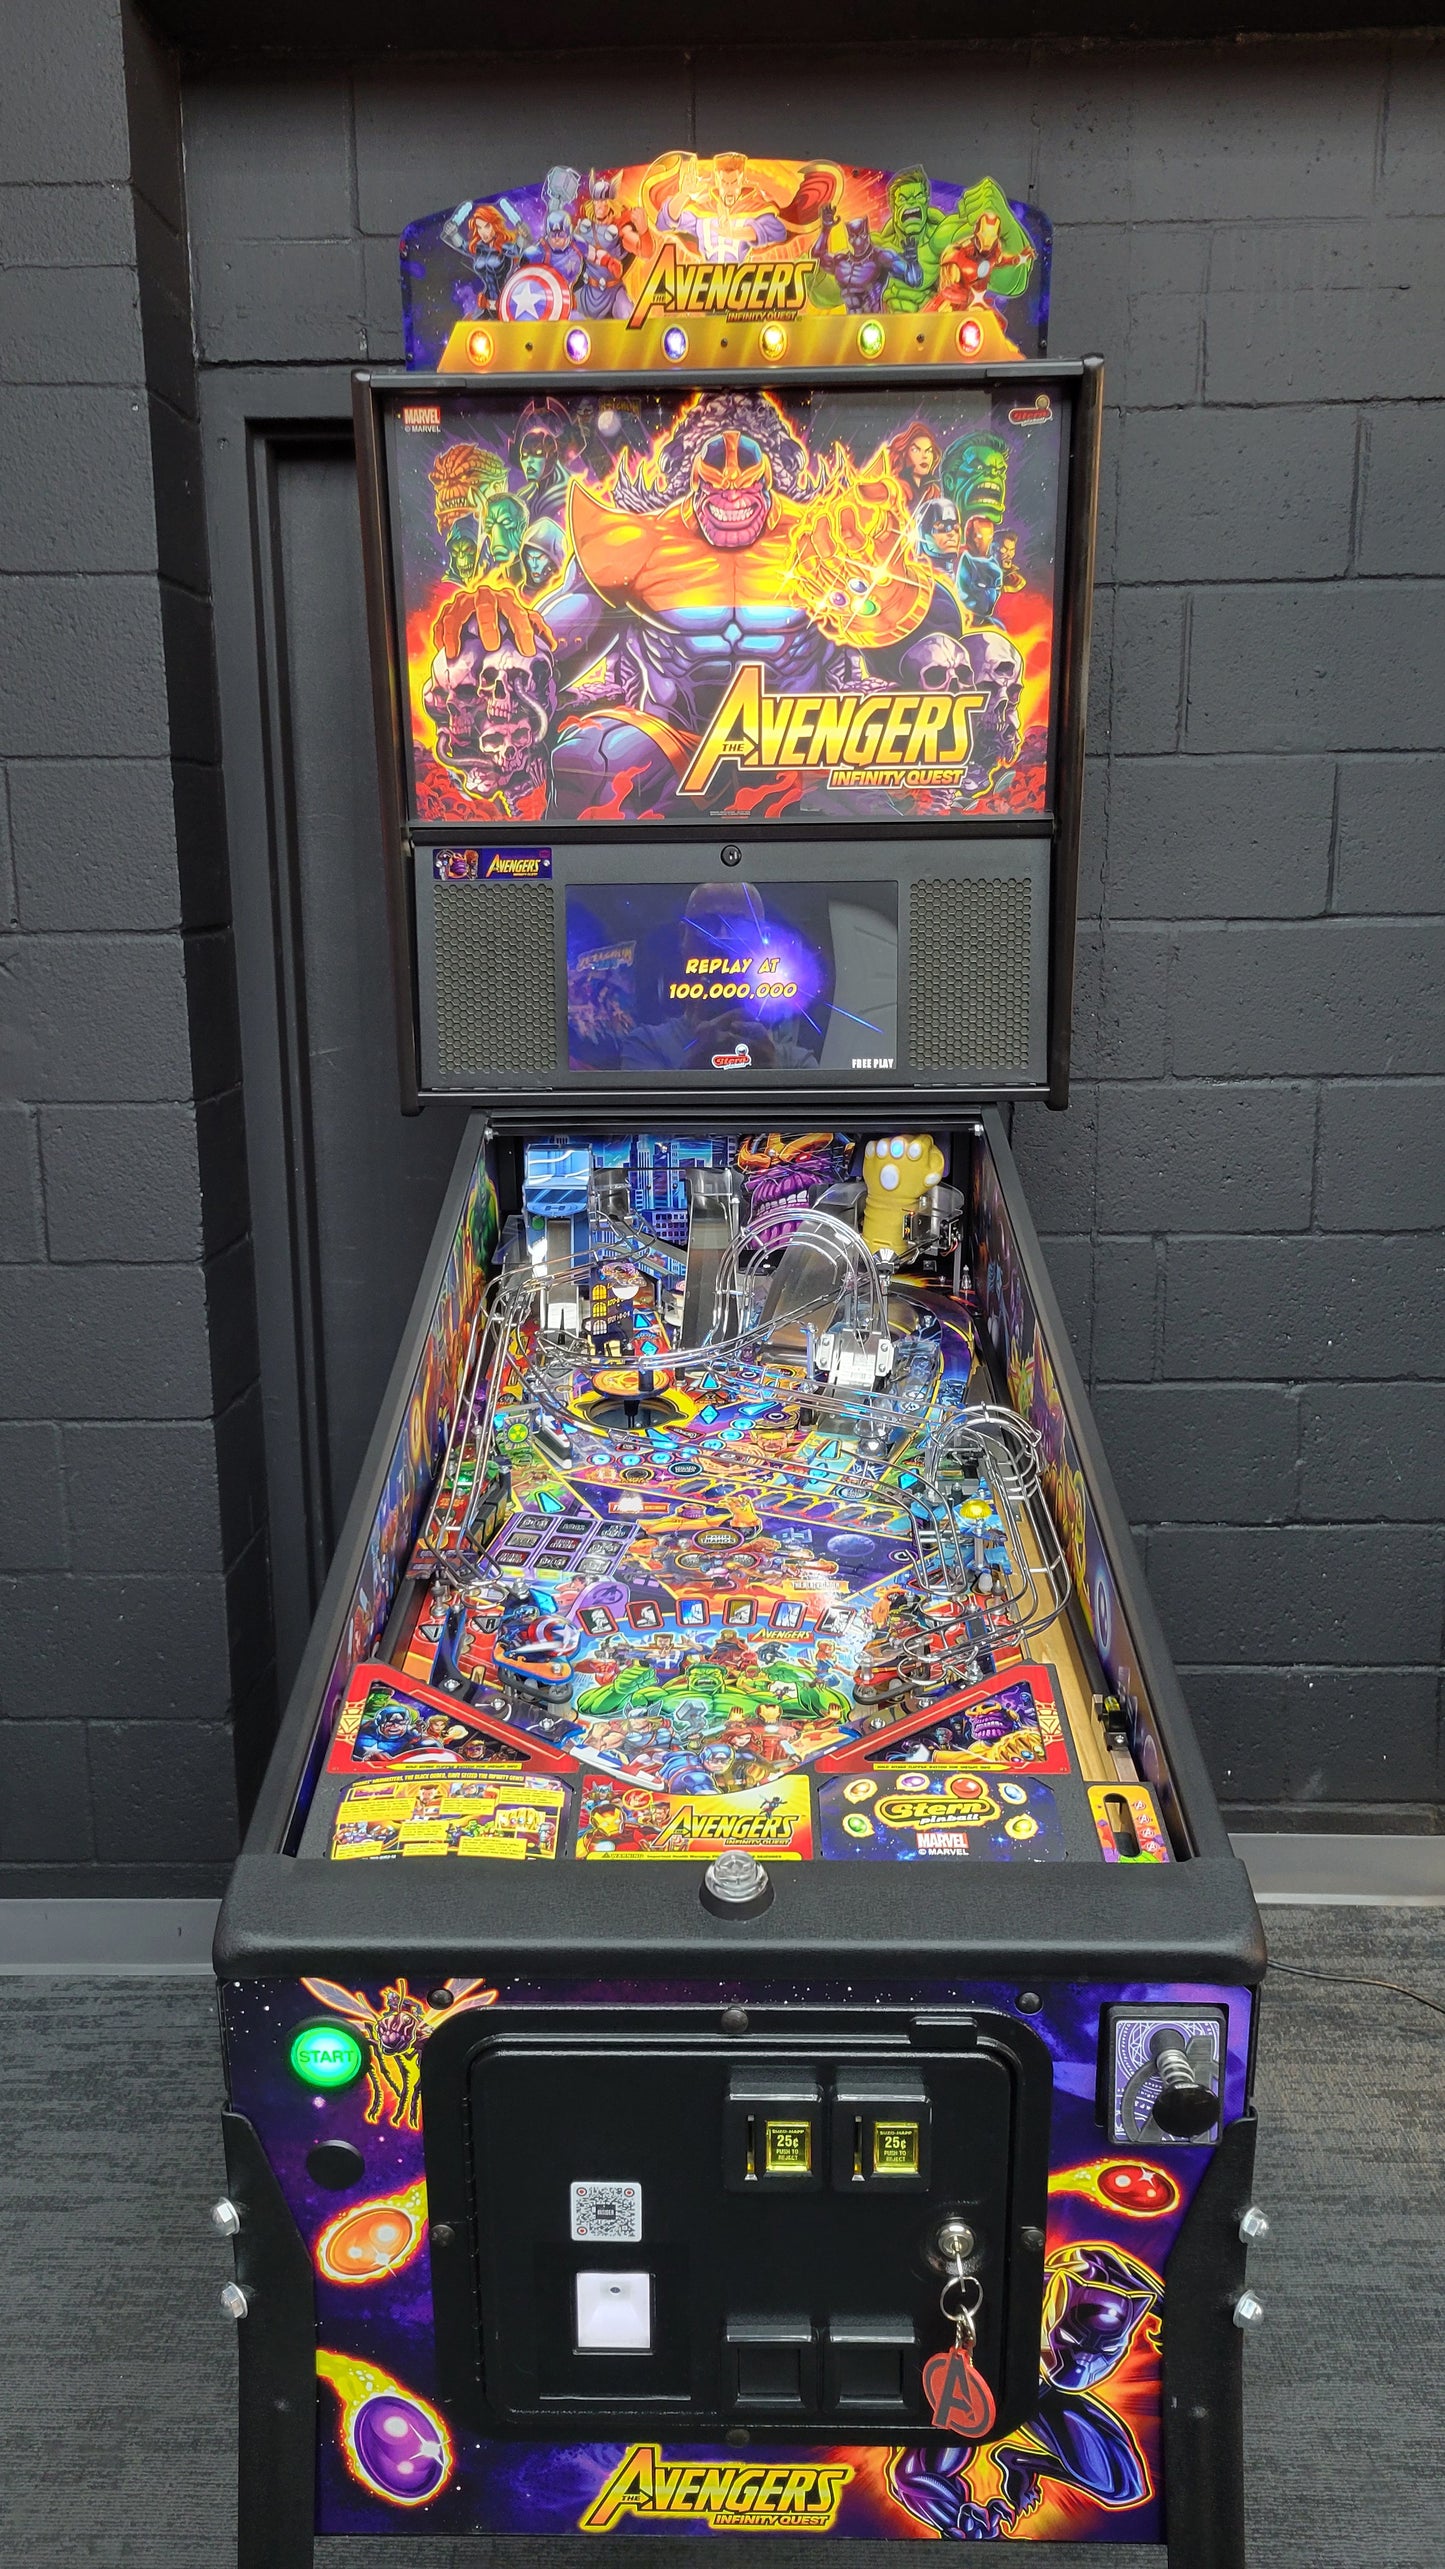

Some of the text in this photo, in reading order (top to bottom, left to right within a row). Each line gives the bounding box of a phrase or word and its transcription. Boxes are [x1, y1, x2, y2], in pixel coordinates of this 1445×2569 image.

[626, 243, 816, 330] AVENGERS
[727, 311, 799, 323] INFINITY QUEST
[403, 408, 440, 424] MARVEL
[412, 425, 441, 433] MARVEL
[678, 661, 989, 795] THE AVENGERS
[830, 768, 965, 787] INFINITY QUEST
[485, 853, 541, 877] AVENGERS
[684, 957, 781, 975] REPLAY AT
[668, 983, 798, 1001] 100,000,000
[852, 1058, 895, 1069] FREE PLAY
[750, 1628, 810, 1641] AVENGERS
[890, 1801, 984, 1819] Stern
[650, 1805, 799, 1848] AVENGERS
[919, 1814, 979, 1826] pinball
[917, 1833, 968, 1848] MARVEL
[918, 1848, 970, 1856] © MARVEL
[300, 2050, 354, 2063] START
[776, 2135, 799, 2148] 25¢
[884, 2136, 907, 2150] 25¢
[586, 2446, 851, 2527] AVENGERS
[714, 2514, 829, 2525] INFINITY QUEST
